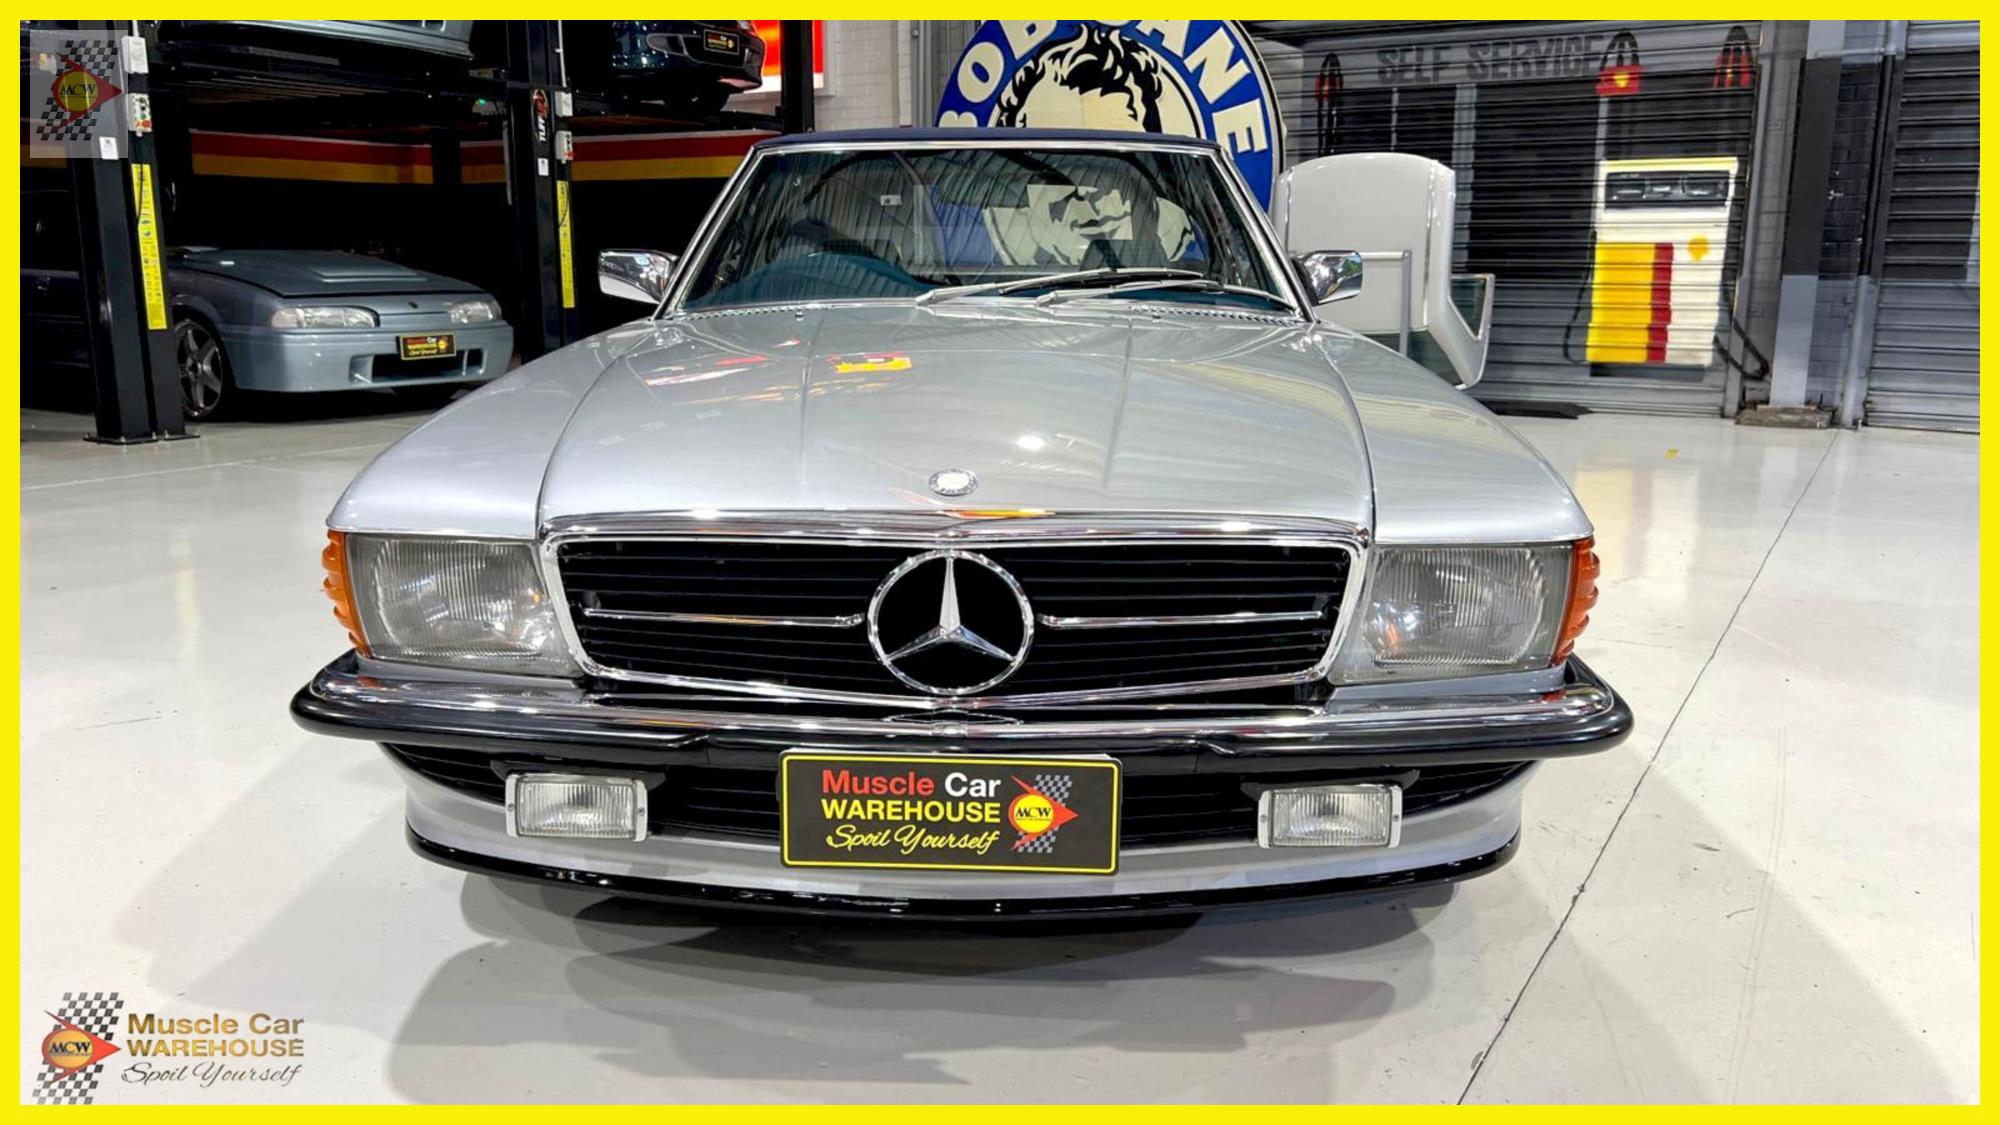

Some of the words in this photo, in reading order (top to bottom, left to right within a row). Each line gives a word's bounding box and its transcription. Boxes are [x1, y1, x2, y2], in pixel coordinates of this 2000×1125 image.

[1377, 46, 1451, 85] SELF
[1466, 35, 1604, 81] SERVICE
[821, 769, 935, 796] Muscle
[944, 772, 1001, 798] Car
[821, 798, 1001, 824] WAREHOUSE
[1015, 807, 1052, 817] MCW
[825, 824, 891, 851] Spoil
[894, 827, 1001, 855] Yourself
